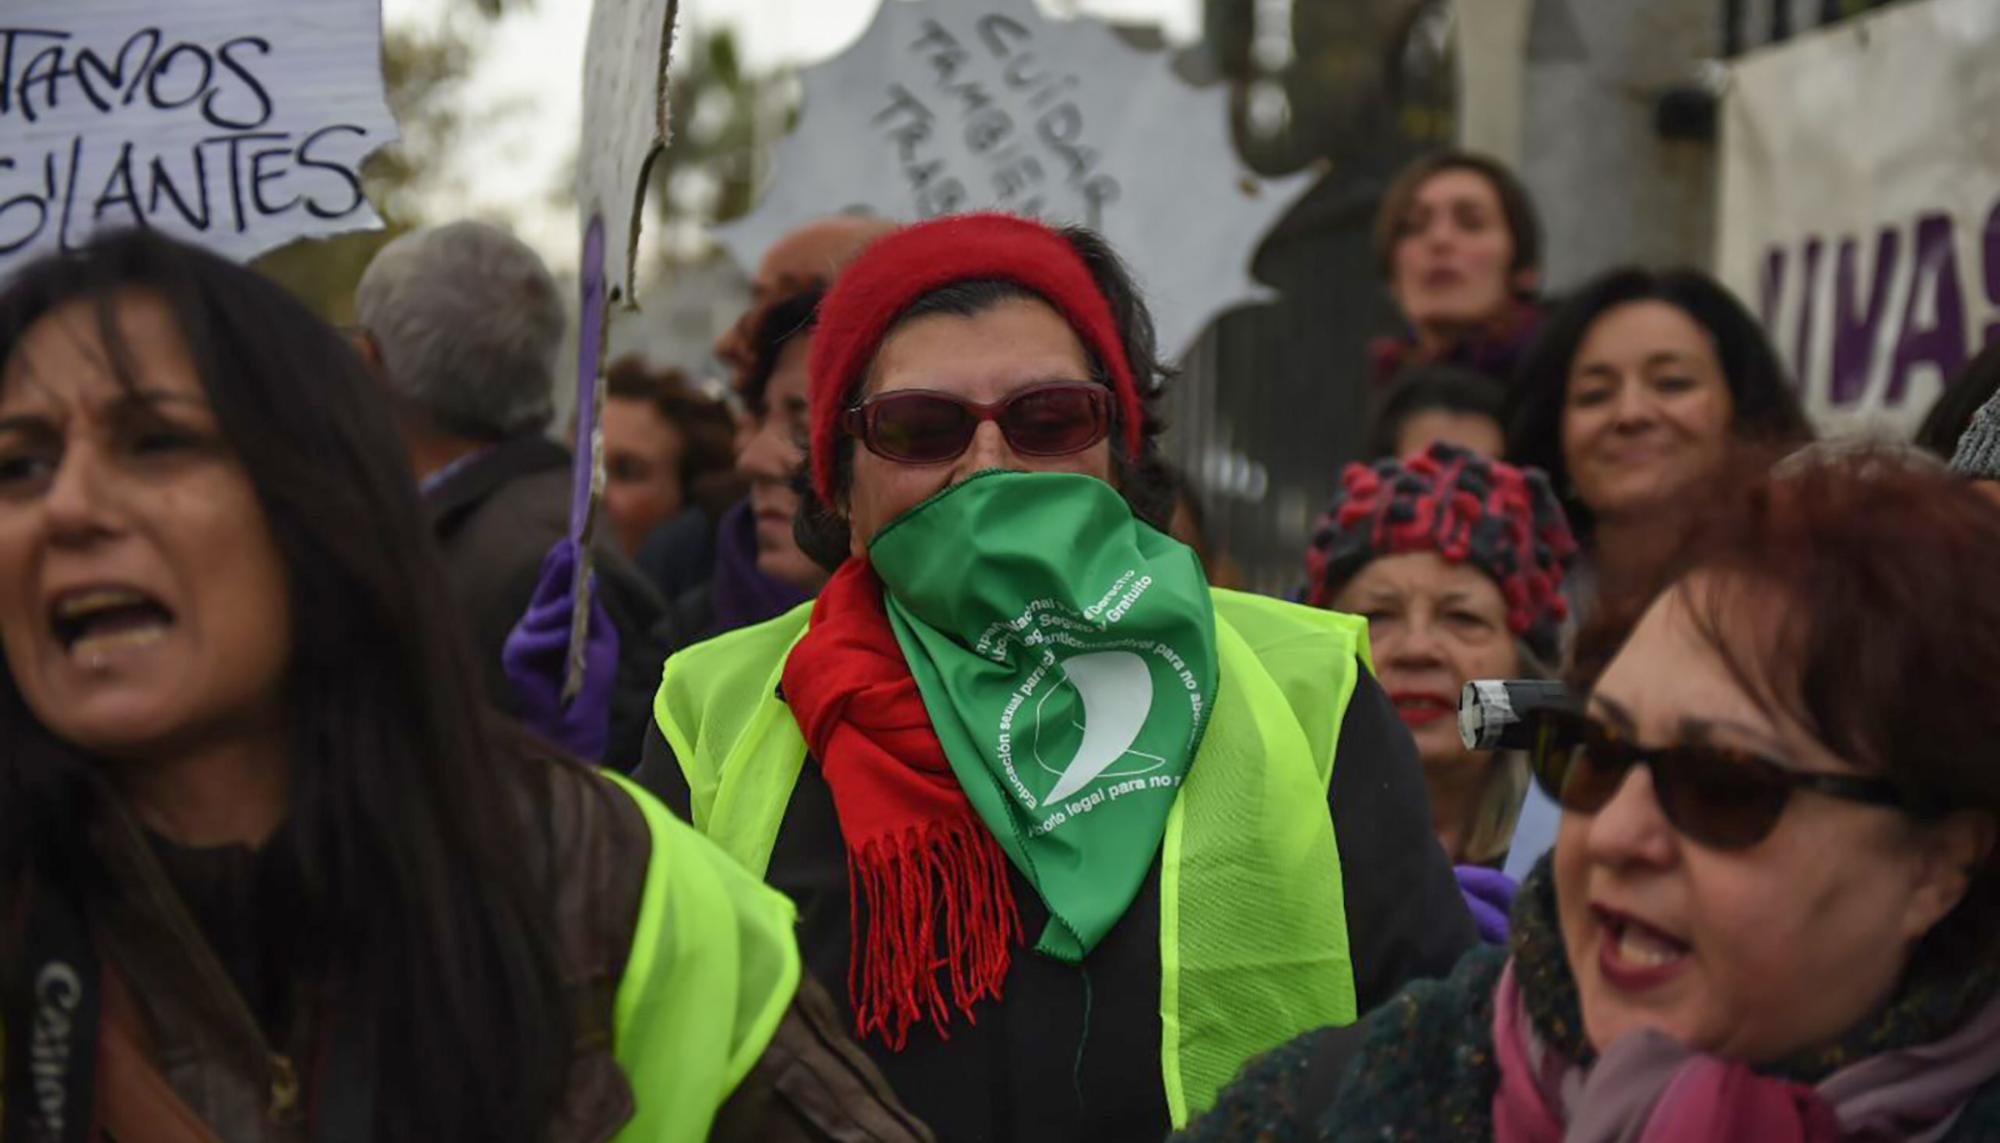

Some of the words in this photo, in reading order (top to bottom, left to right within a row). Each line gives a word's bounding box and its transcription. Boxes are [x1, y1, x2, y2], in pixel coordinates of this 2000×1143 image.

[0, 27, 273, 131] TAMOS
[1105, 575, 1153, 623] Gratuito
[1153, 641, 1185, 672] para
[1180, 669, 1197, 690] no
[1000, 692, 1025, 730] sexual
[997, 734, 1038, 811] Educación
[1065, 787, 1106, 818] legal
[1108, 777, 1147, 801] para
[1149, 774, 1171, 789] no
